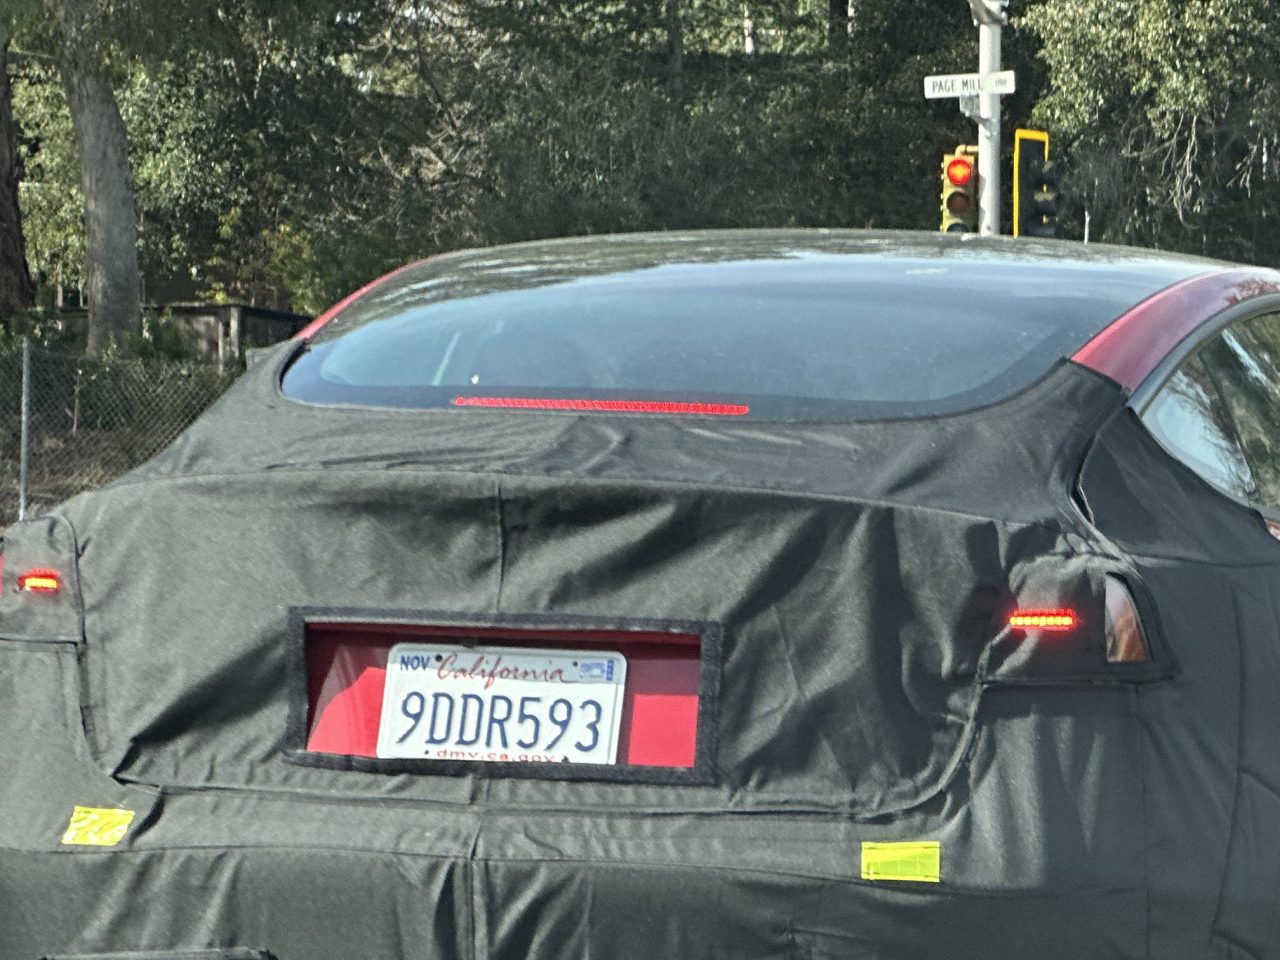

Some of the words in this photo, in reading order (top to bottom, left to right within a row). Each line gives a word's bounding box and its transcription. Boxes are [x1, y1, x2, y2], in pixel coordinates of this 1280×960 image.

[932, 79, 956, 94] PAGE
[961, 77, 984, 91] MILL
[400, 654, 431, 672] NOV
[436, 653, 577, 690] California
[395, 691, 604, 752] 9DDR593
[436, 749, 556, 763] dmv.ca.gov
